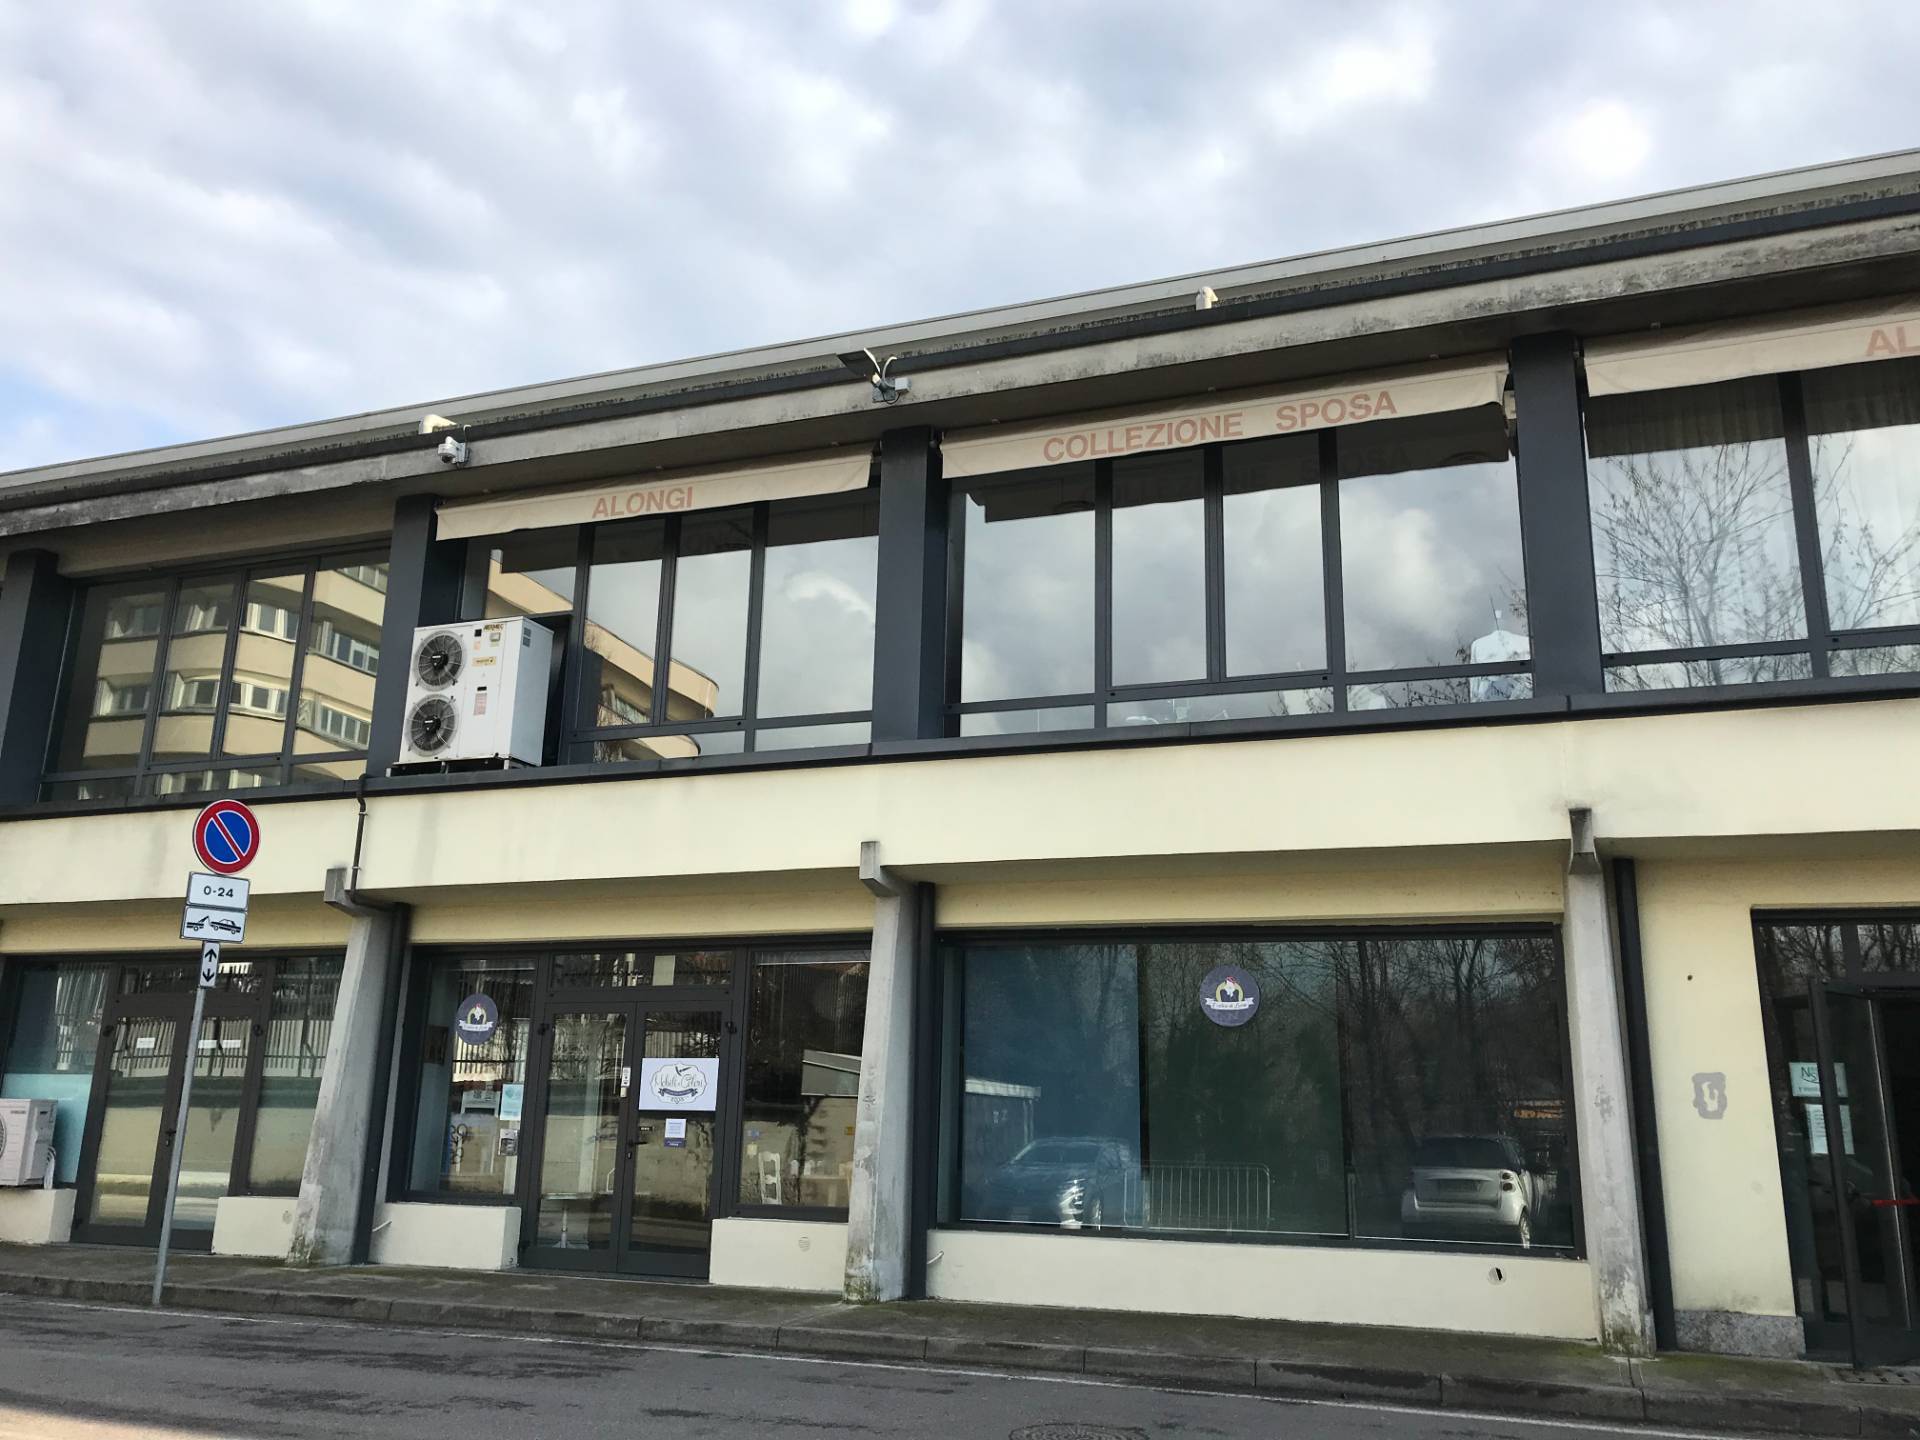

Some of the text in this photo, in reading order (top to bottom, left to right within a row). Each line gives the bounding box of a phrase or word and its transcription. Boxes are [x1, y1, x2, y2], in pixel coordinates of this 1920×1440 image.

[1044, 390, 1398, 462] COLLEZIONE SPOSA
[592, 486, 693, 518] ALONGI
[203, 885, 234, 898] 0-24
